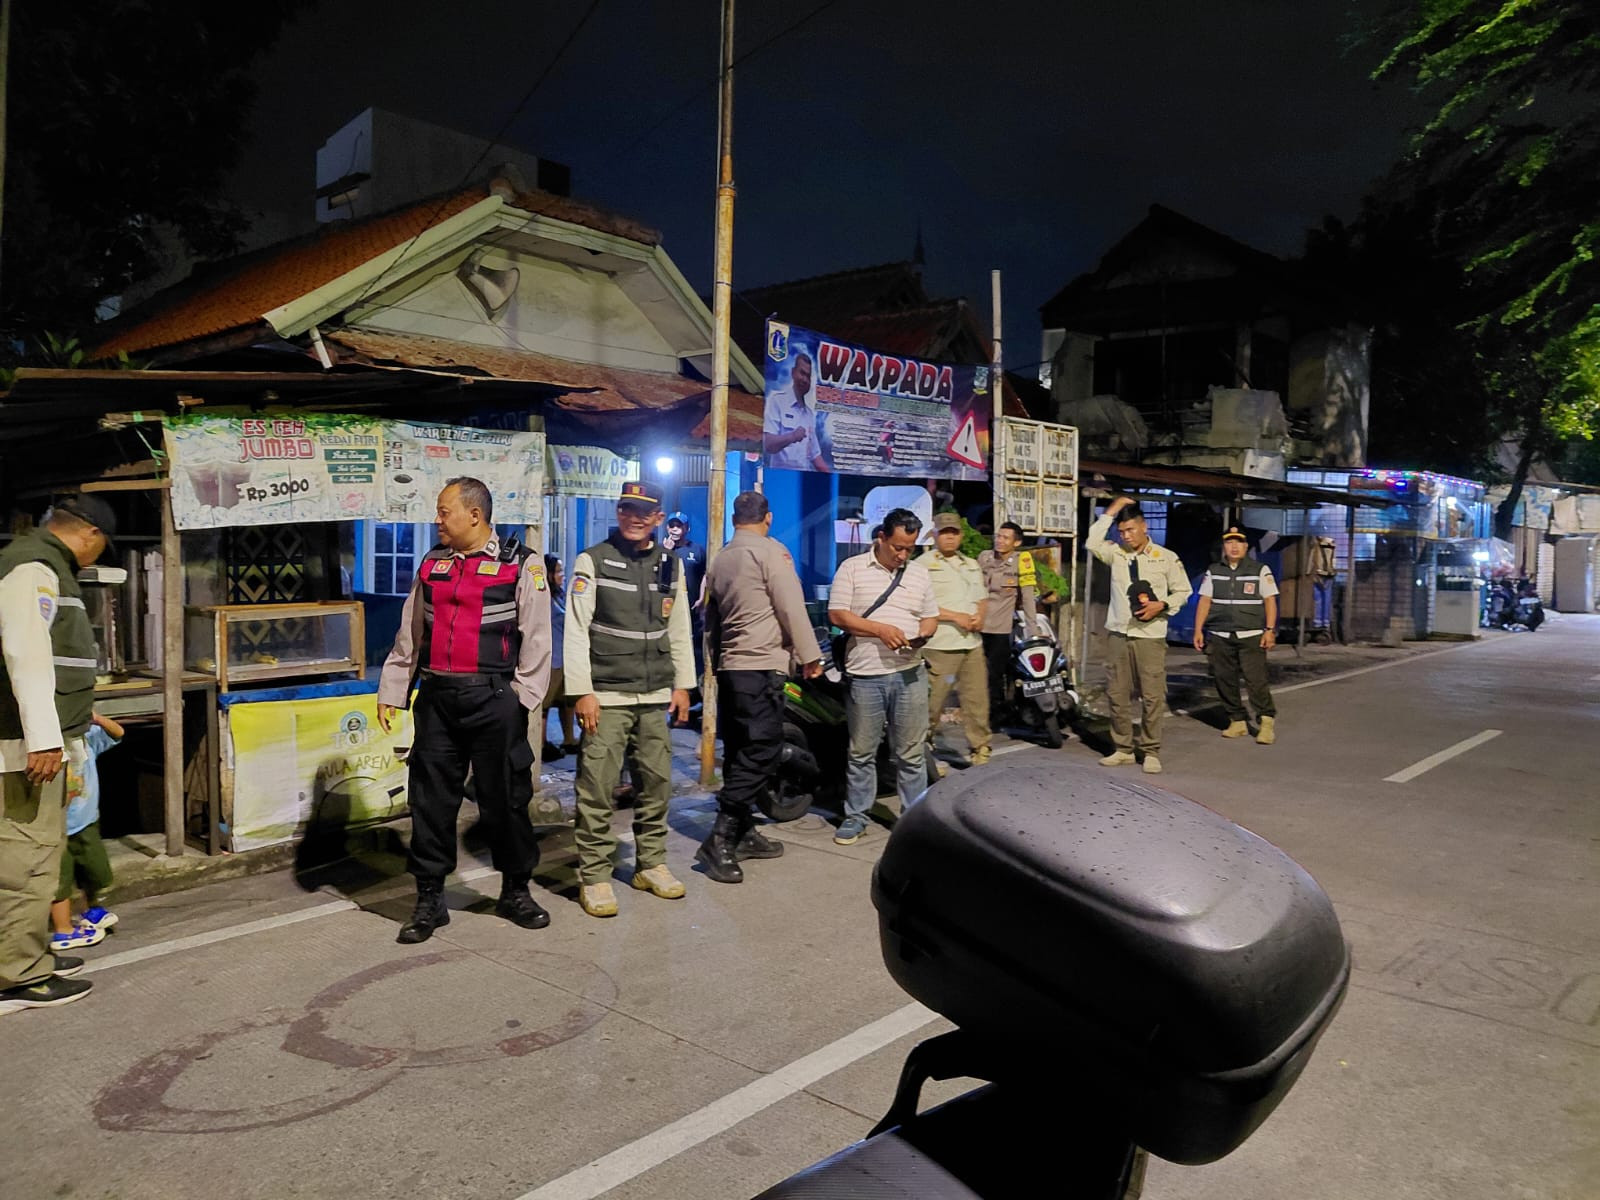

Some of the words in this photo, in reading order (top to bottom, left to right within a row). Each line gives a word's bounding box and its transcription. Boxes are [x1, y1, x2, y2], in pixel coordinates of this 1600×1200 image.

[818, 342, 953, 402] WASPADA
[243, 419, 266, 435] ES
[272, 419, 305, 436] TEH
[239, 438, 315, 461] JUMBO
[610, 458, 628, 477] 05
[246, 487, 267, 501] Rp
[270, 479, 309, 496] 3000
[331, 728, 377, 748] TOP
[356, 755, 391, 770] AREN
